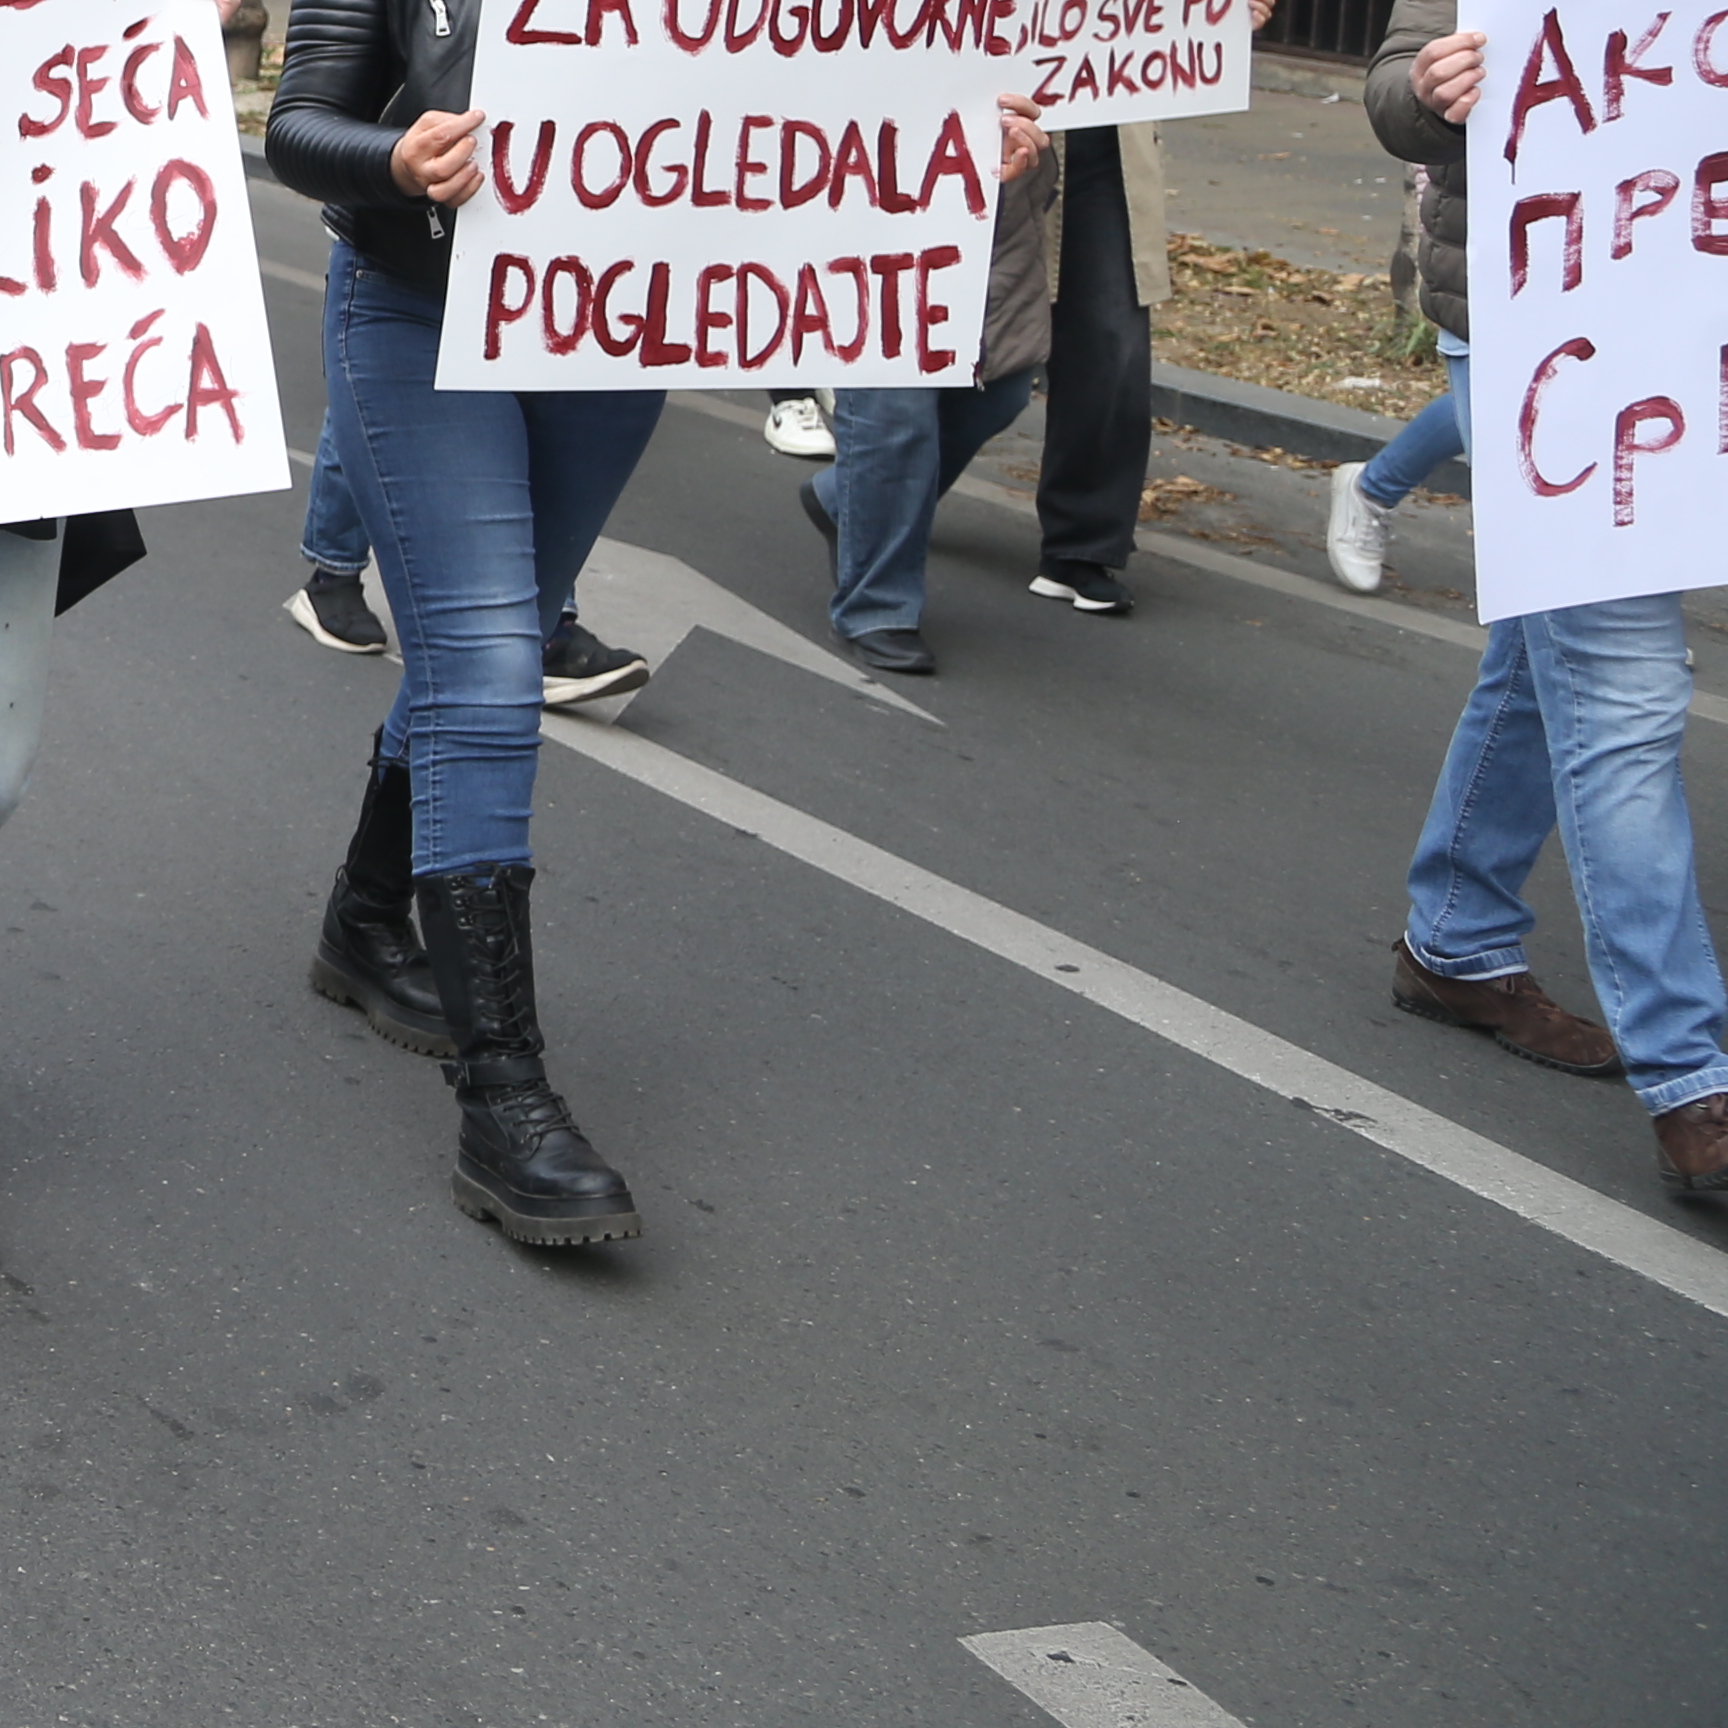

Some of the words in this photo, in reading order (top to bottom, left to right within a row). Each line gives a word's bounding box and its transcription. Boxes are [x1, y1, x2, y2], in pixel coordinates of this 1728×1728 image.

[17, 16, 211, 140] SEĆA
[1031, 37, 1224, 107] ZAKONU
[488, 119, 556, 217] U
[570, 109, 990, 222] OGLEDALA
[483, 244, 964, 376] POGLEDAJTE
